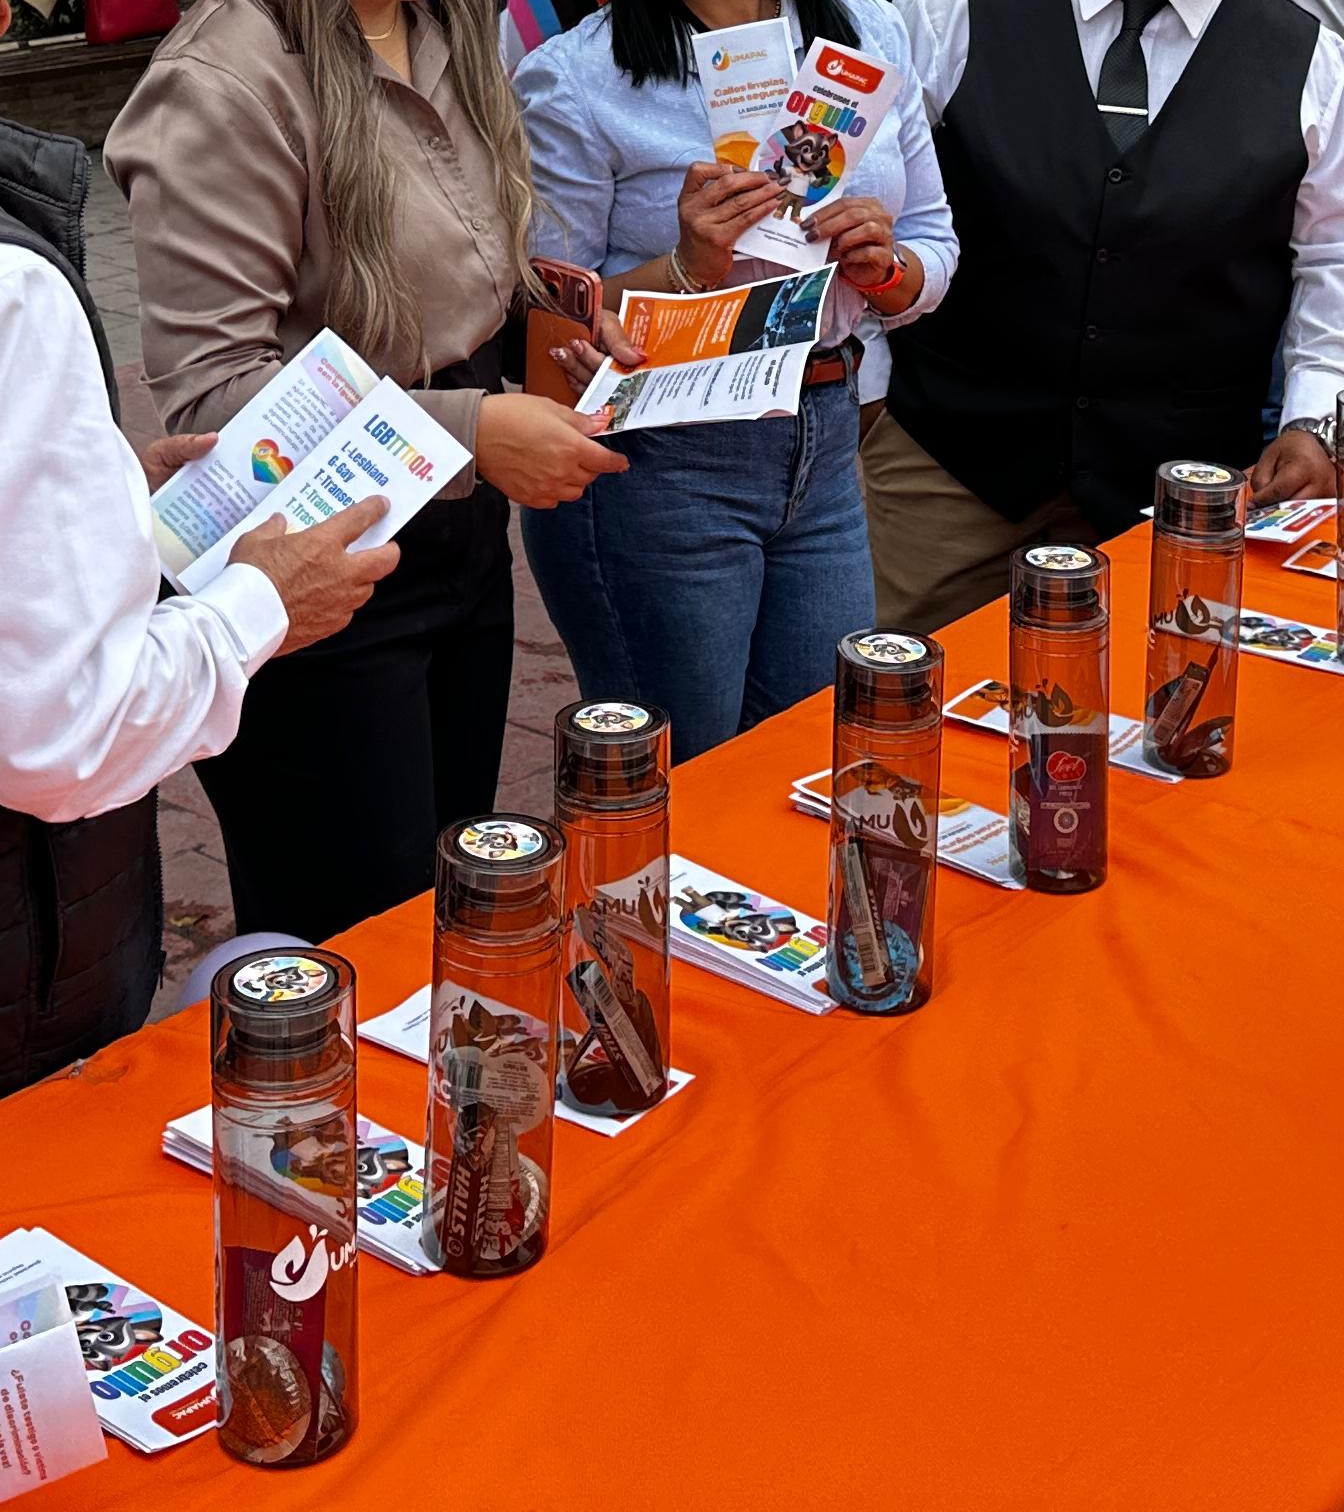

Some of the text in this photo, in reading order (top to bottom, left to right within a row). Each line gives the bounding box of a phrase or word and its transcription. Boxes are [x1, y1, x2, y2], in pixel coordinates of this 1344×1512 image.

[785, 90, 867, 138] orgullo
[328, 455, 356, 483] G-Gay
[340, 440, 390, 487] L-Lesbiana
[363, 414, 434, 482] LGBTTTIQA+
[299, 483, 337, 519] T-Trans
[450, 1166, 471, 1236] HALLS
[88, 1329, 212, 1392] orgullo
[136, 1360, 208, 1404] celebremos el
[10, 1366, 31, 1411] ¿Fuiste
[21, 1410, 38, 1446] testigo
